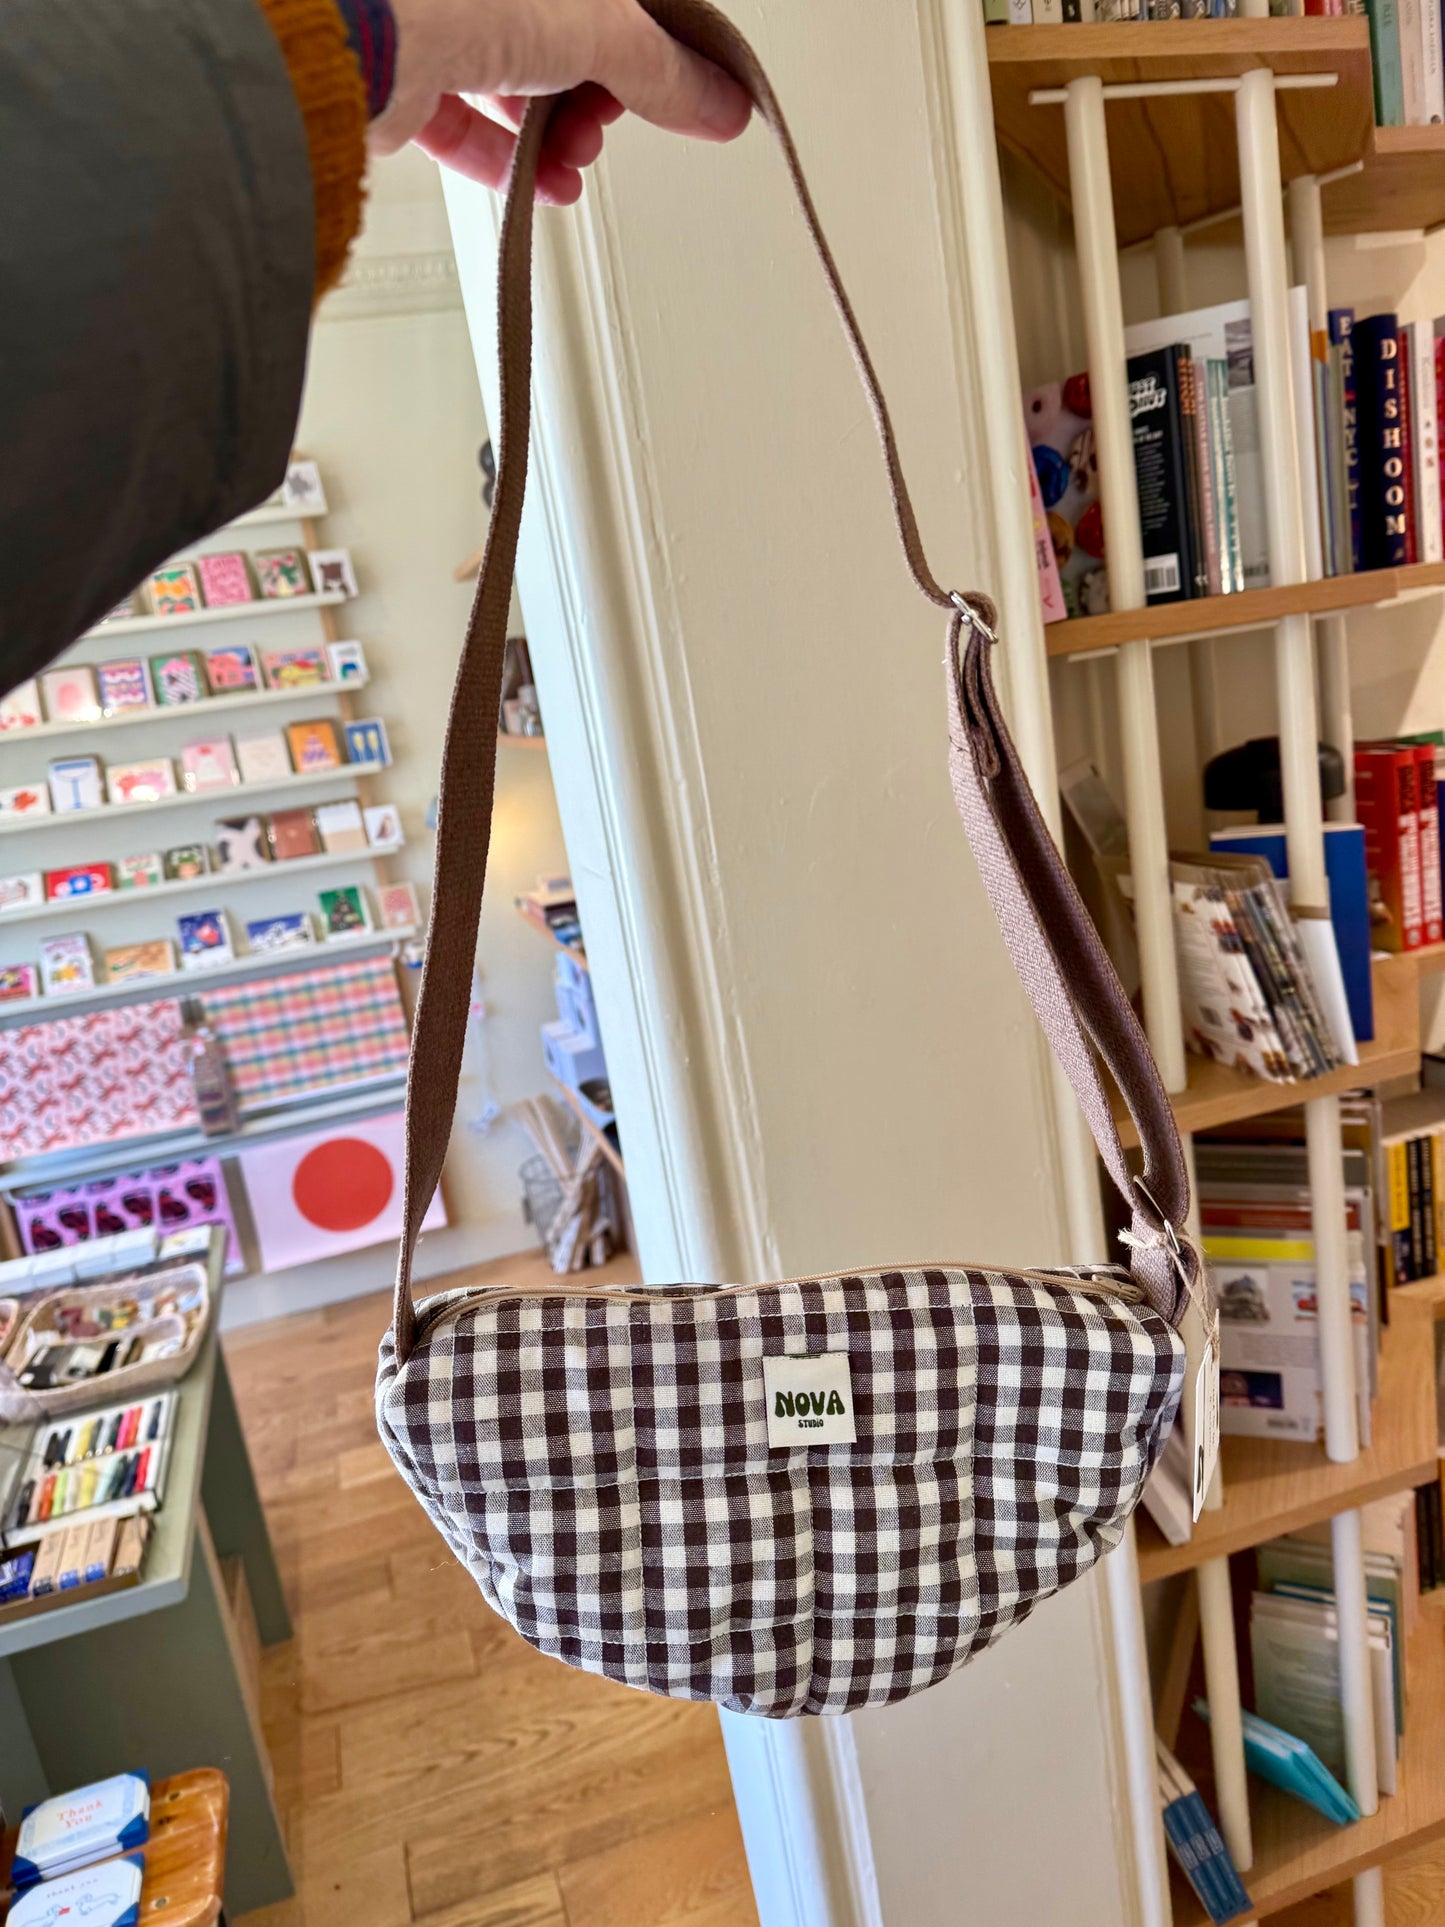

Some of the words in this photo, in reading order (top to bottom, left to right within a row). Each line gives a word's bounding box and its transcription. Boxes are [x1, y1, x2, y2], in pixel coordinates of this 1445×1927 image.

[1381, 338, 1406, 535] DISHOOM
[775, 1390, 845, 1417] NOVA
[57, 1800, 103, 1822] Thank
[65, 1814, 93, 1829] You
